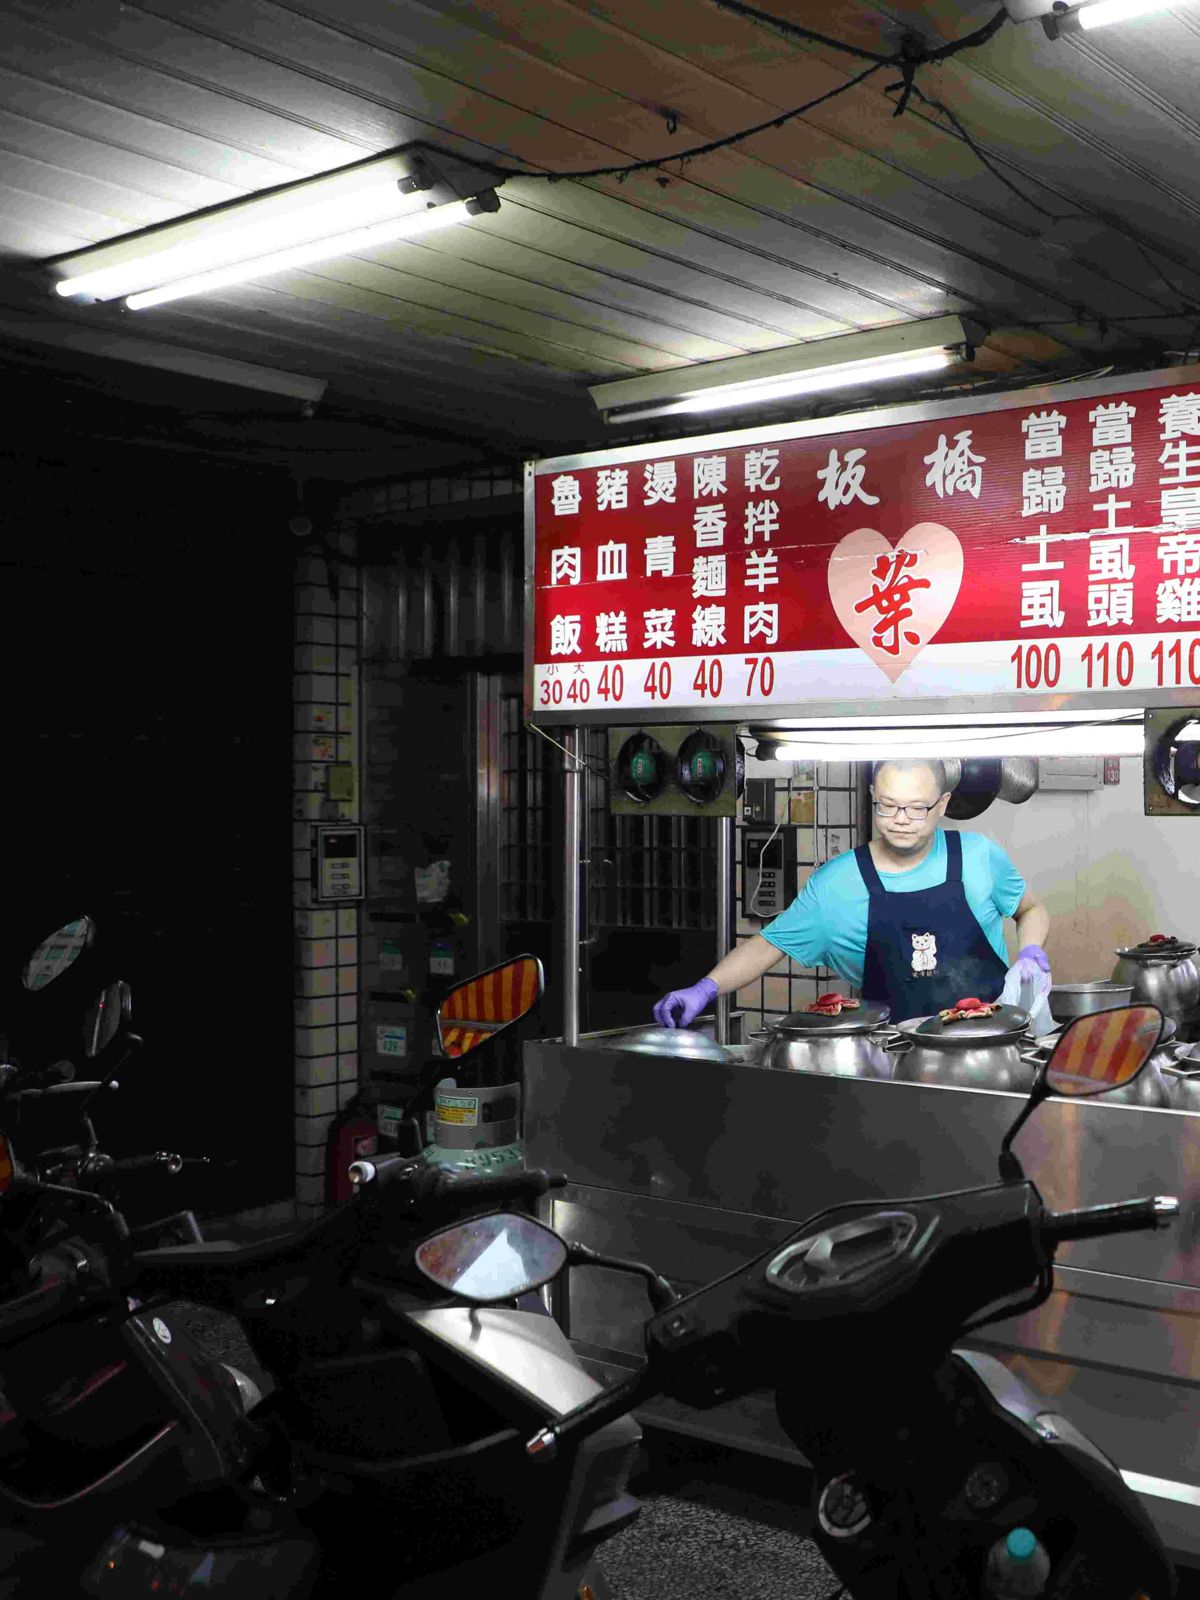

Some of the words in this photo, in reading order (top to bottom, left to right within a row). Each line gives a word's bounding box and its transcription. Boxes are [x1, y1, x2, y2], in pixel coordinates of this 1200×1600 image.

[817, 430, 987, 511] 板橋
[1020, 410, 1068, 628] 當歸土虱
[1087, 402, 1137, 627] 當歸土虱頭
[550, 475, 582, 656] 魯肉飯
[595, 469, 629, 654] 豬血糕
[643, 462, 678, 650] 燙青菜
[691, 455, 727, 647] 陳香麵線
[743, 447, 780, 645] 乾拌羊肉
[855, 549, 931, 656] 葉
[546, 665, 559, 676] 小
[573, 663, 585, 675] 大
[597, 663, 625, 701] 40
[644, 661, 672, 699] 40
[693, 658, 722, 698] 40
[745, 657, 774, 697] 70
[1011, 643, 1061, 689] 100
[1081, 641, 1134, 689] 110
[540, 679, 563, 705] 30
[567, 678, 590, 704] 40
